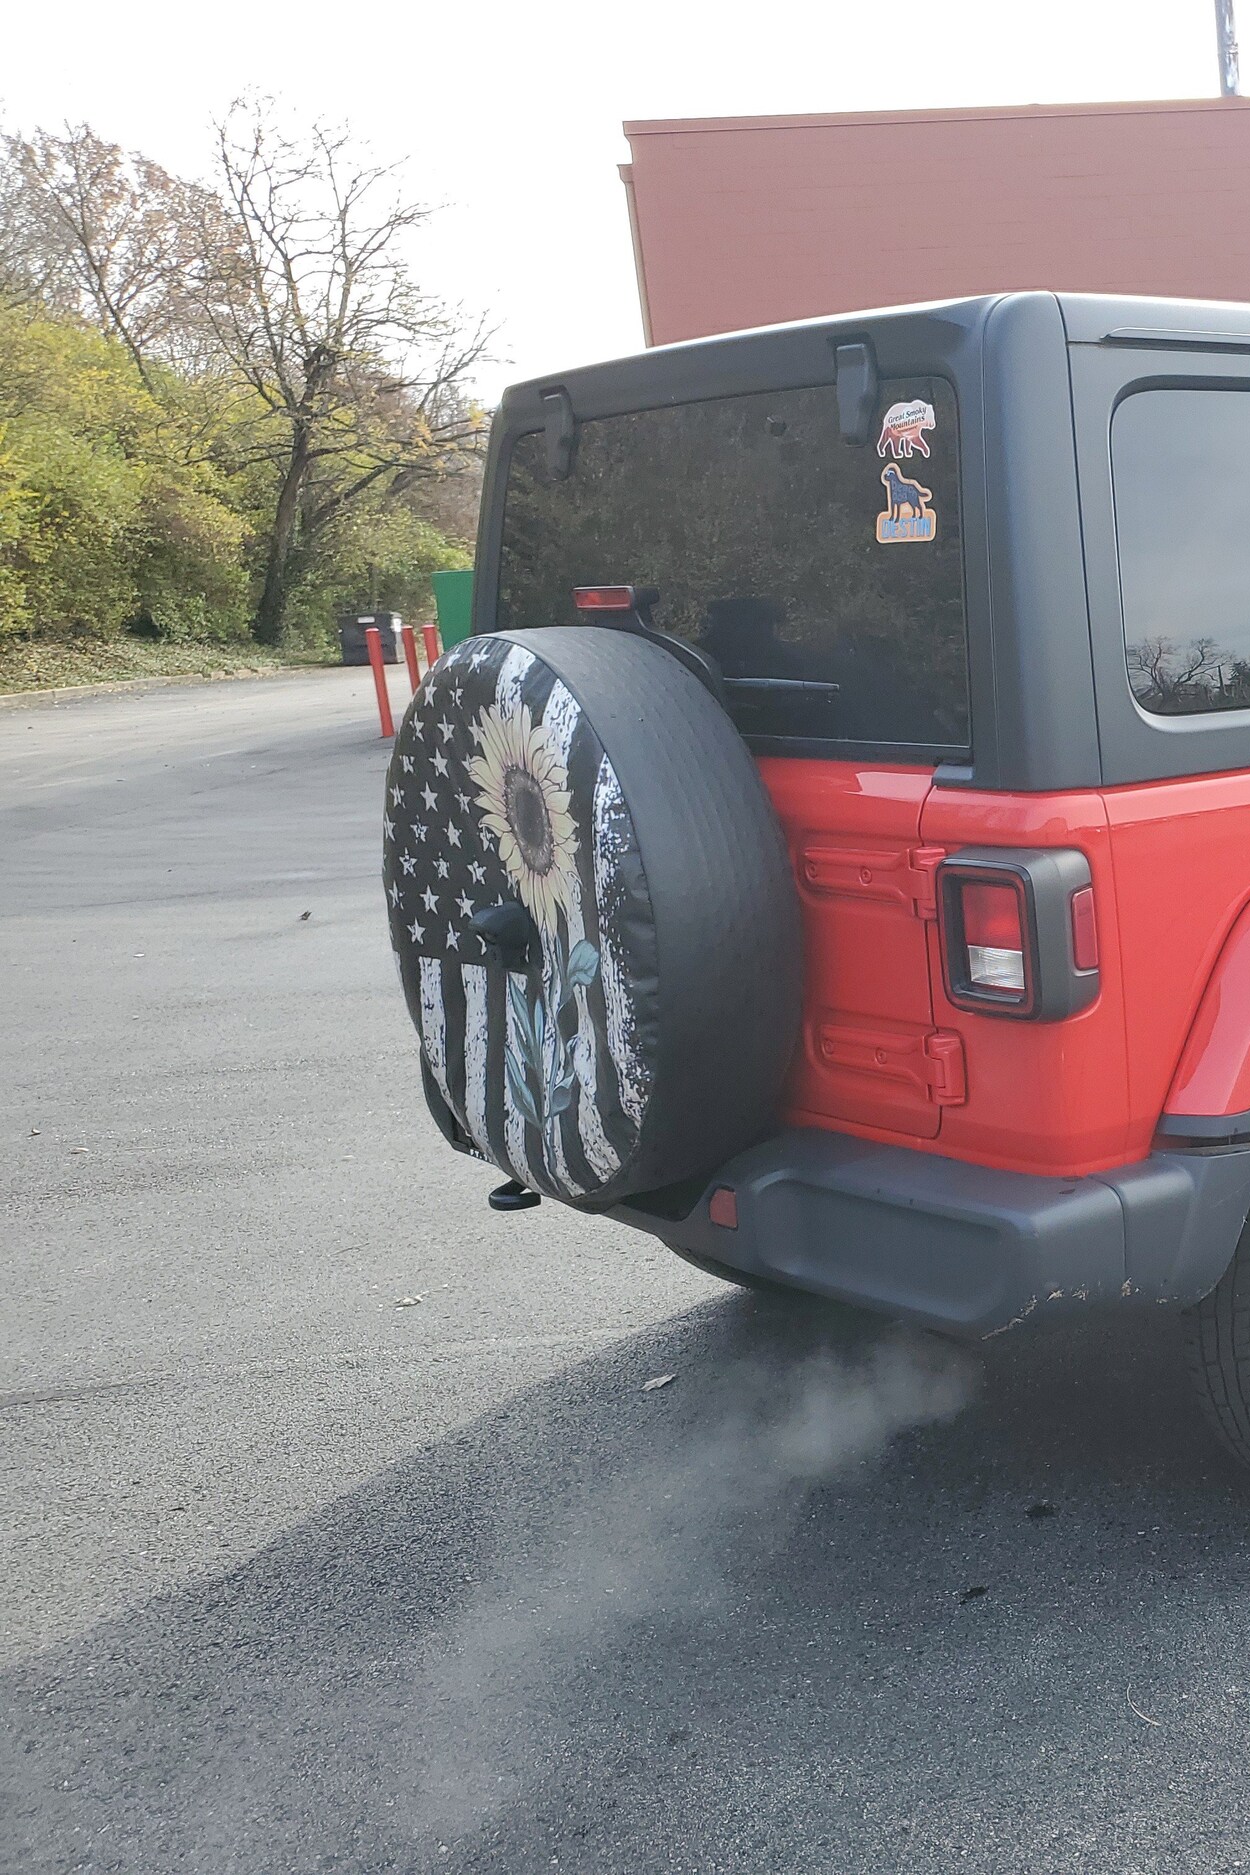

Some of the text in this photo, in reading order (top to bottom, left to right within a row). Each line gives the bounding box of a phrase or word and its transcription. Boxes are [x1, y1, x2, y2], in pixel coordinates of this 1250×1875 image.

[887, 406, 927, 424] Great Smoky
[890, 415, 926, 430] Mountains
[881, 517, 932, 538] DESTIN
